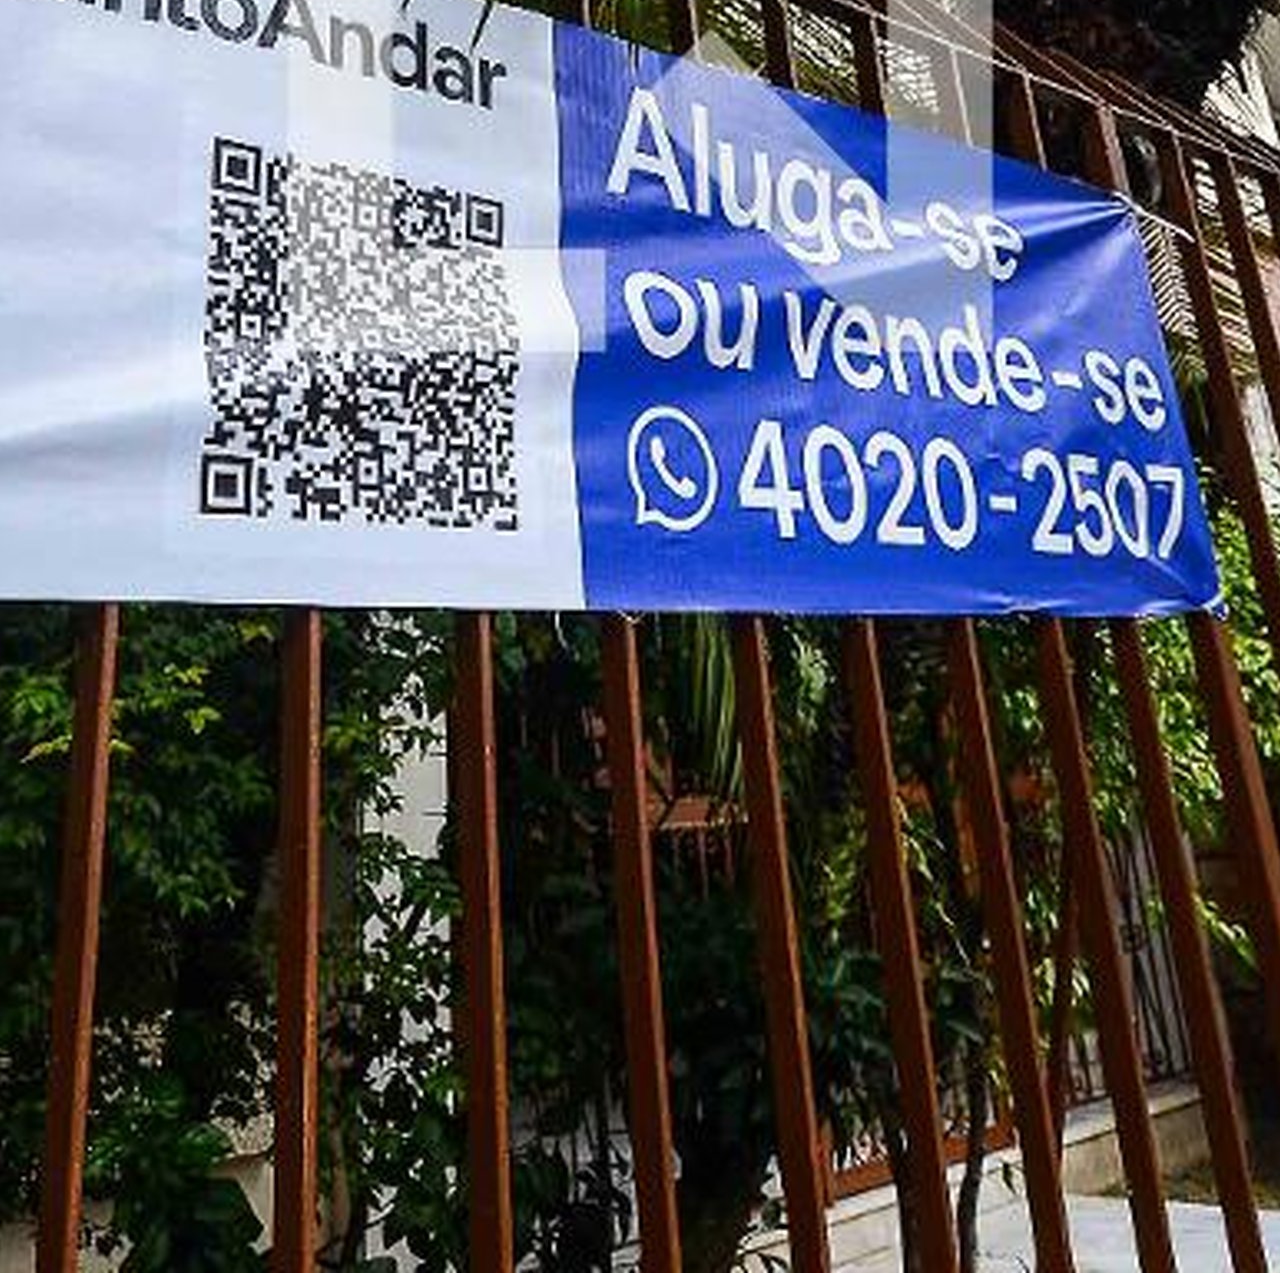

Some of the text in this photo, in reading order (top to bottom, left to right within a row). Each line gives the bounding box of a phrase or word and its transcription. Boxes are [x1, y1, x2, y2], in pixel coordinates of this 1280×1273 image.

[606, 86, 1024, 281] Aluga-se
[622, 270, 1166, 432] ou vende-se
[738, 419, 1184, 560] 4020-2507
